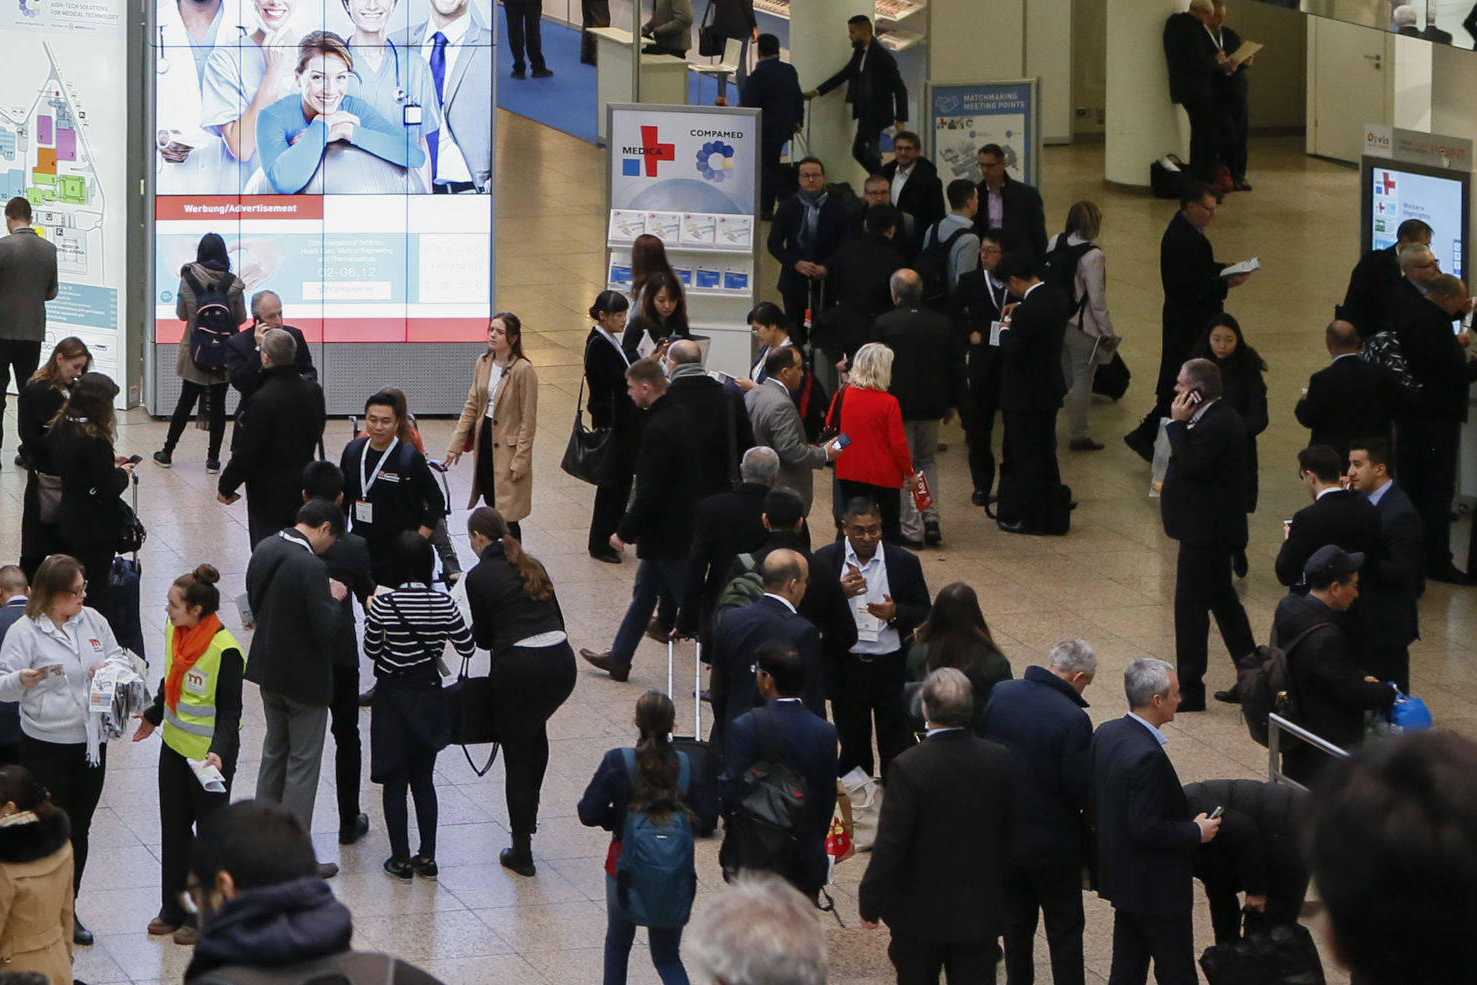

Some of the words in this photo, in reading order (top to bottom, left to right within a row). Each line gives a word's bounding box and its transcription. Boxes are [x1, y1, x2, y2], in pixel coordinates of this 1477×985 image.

[964, 93, 1017, 101] MATCHMAKING
[964, 102, 996, 110] MEETING
[690, 130, 743, 139] COMPAMED
[622, 147, 662, 156] MEDICA
[184, 203, 298, 215] Werbung/Advertisement
